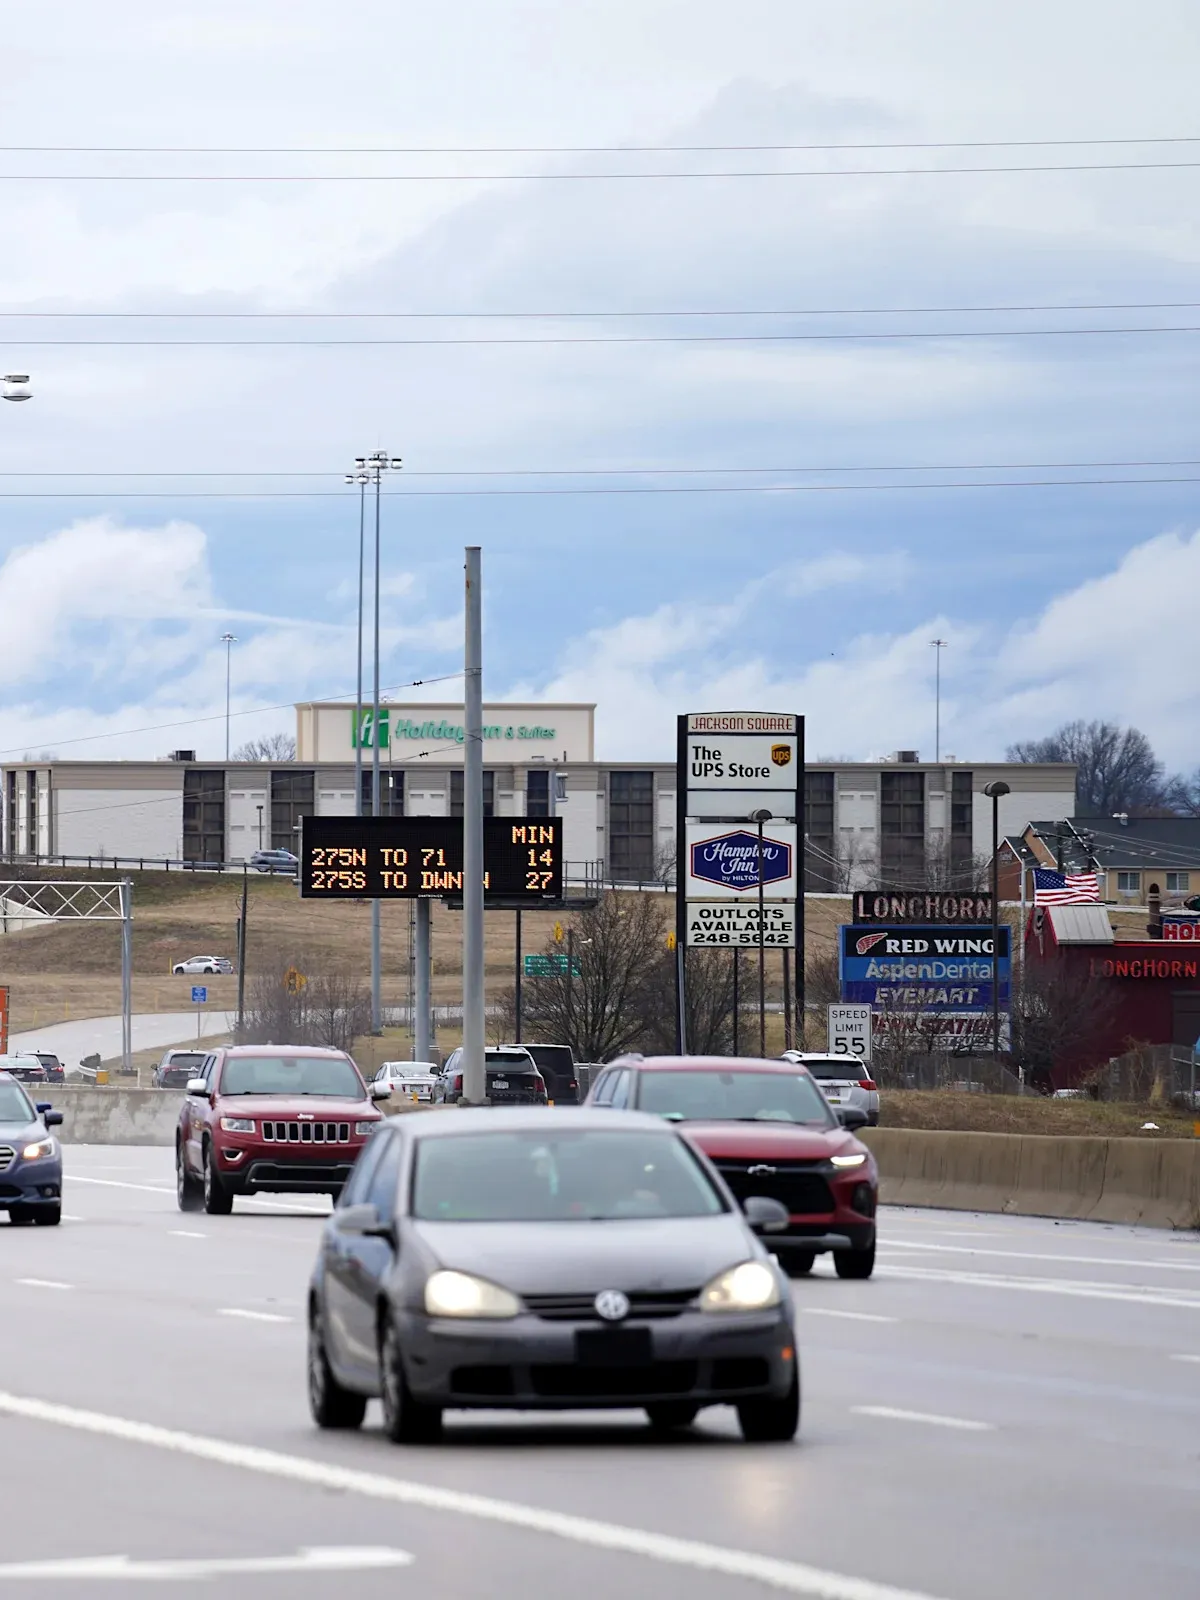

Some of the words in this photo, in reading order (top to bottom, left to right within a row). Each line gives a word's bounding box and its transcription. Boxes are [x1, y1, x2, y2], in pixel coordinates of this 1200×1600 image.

[395, 719, 464, 742] Holiday
[505, 726, 514, 739] &
[517, 726, 556, 740] Suites
[692, 717, 744, 730] JACKSON
[747, 717, 793, 730] SQUARE
[692, 746, 722, 761] The
[772, 750, 790, 765] ups
[692, 763, 724, 777] UPS
[728, 763, 771, 778] Store
[511, 826, 554, 844] MIN
[311, 848, 367, 866] 275N
[380, 848, 408, 866] TO
[420, 848, 446, 866] 71
[527, 848, 553, 866] 14
[720, 858, 760, 874] Inn
[311, 871, 367, 889] 275S
[380, 871, 408, 889] TO
[525, 871, 553, 889] 27
[699, 909, 784, 919] OUTLOTS
[690, 922, 793, 931] AVAILABLE
[693, 934, 789, 943] 248-5642
[885, 939, 929, 954] RED
[933, 939, 994, 954] WING
[864, 958, 994, 982] AspenDental
[1088, 958, 1197, 978] LONGHORN
[874, 987, 979, 1004] EYEMART
[831, 1010, 868, 1019] SPEED
[835, 1023, 864, 1032] LIMIT
[834, 1037, 866, 1055] 55
